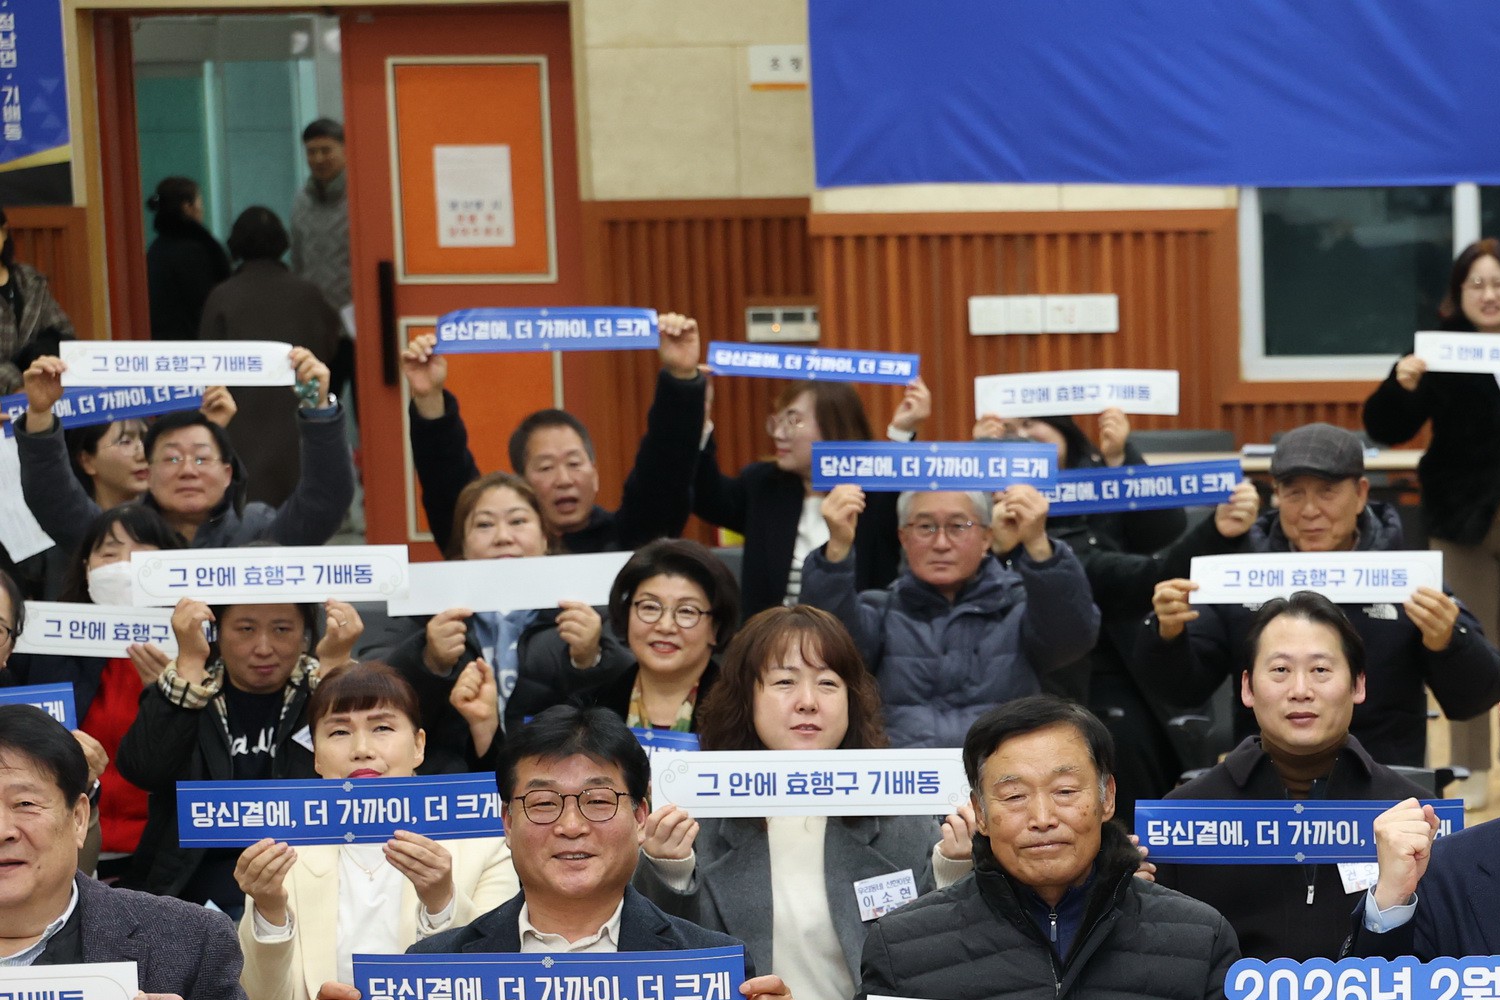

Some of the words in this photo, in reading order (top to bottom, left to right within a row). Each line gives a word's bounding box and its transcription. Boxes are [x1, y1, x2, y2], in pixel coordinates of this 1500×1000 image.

[441, 321, 511, 340] 당신곁에,
[516, 321, 532, 338] 더
[537, 320, 591, 338] 가까이,
[595, 319, 612, 337] 더
[616, 319, 650, 336] 크게
[92, 356, 108, 371] 그
[115, 357, 148, 371] 안에
[156, 356, 205, 371] 효행구
[213, 357, 262, 371] 기배동
[715, 350, 781, 368] 당신곁에,
[785, 355, 802, 369] 더
[806, 356, 855, 372] 가까이,
[859, 360, 875, 373] 더
[879, 361, 911, 375] 크게
[78, 395, 95, 413] 더
[102, 390, 151, 409] 가까이,
[154, 386, 171, 402] 더
[821, 456, 897, 477] 당신곁에,
[902, 457, 919, 476] 더
[925, 457, 984, 477] 가까이,
[989, 458, 1006, 477] 더
[1011, 458, 1048, 477] 크게
[1040, 483, 1098, 504] 신곁에,
[1102, 481, 1119, 499] 더
[1123, 477, 1177, 497] 가까이,
[1181, 475, 1198, 494] 더
[1203, 474, 1235, 494] 크게
[168, 566, 190, 588] 그
[196, 567, 235, 587] 안에
[244, 566, 305, 585] 효행구
[313, 565, 372, 584] 기배동
[1224, 571, 1240, 587] 그
[1248, 570, 1283, 587] 안에
[1292, 569, 1345, 586] 효행구
[1354, 569, 1407, 586] 기배동
[44, 620, 62, 637] 그
[70, 621, 105, 640] 안에
[111, 620, 169, 643] 효행구
[697, 774, 720, 796] 그
[730, 773, 776, 796] 안에
[786, 772, 859, 795] 효행구
[868, 771, 940, 794] 기배동
[192, 801, 296, 828] 당신곁에,
[305, 800, 327, 825] 더
[337, 798, 417, 824] 가까이,
[425, 796, 447, 821] 더
[456, 793, 502, 819] 크게
[1148, 821, 1249, 847] 당신곁에,
[1257, 821, 1278, 845] 더
[1288, 821, 1365, 846] 가까이,
[675, 972, 730, 1000] 크게
